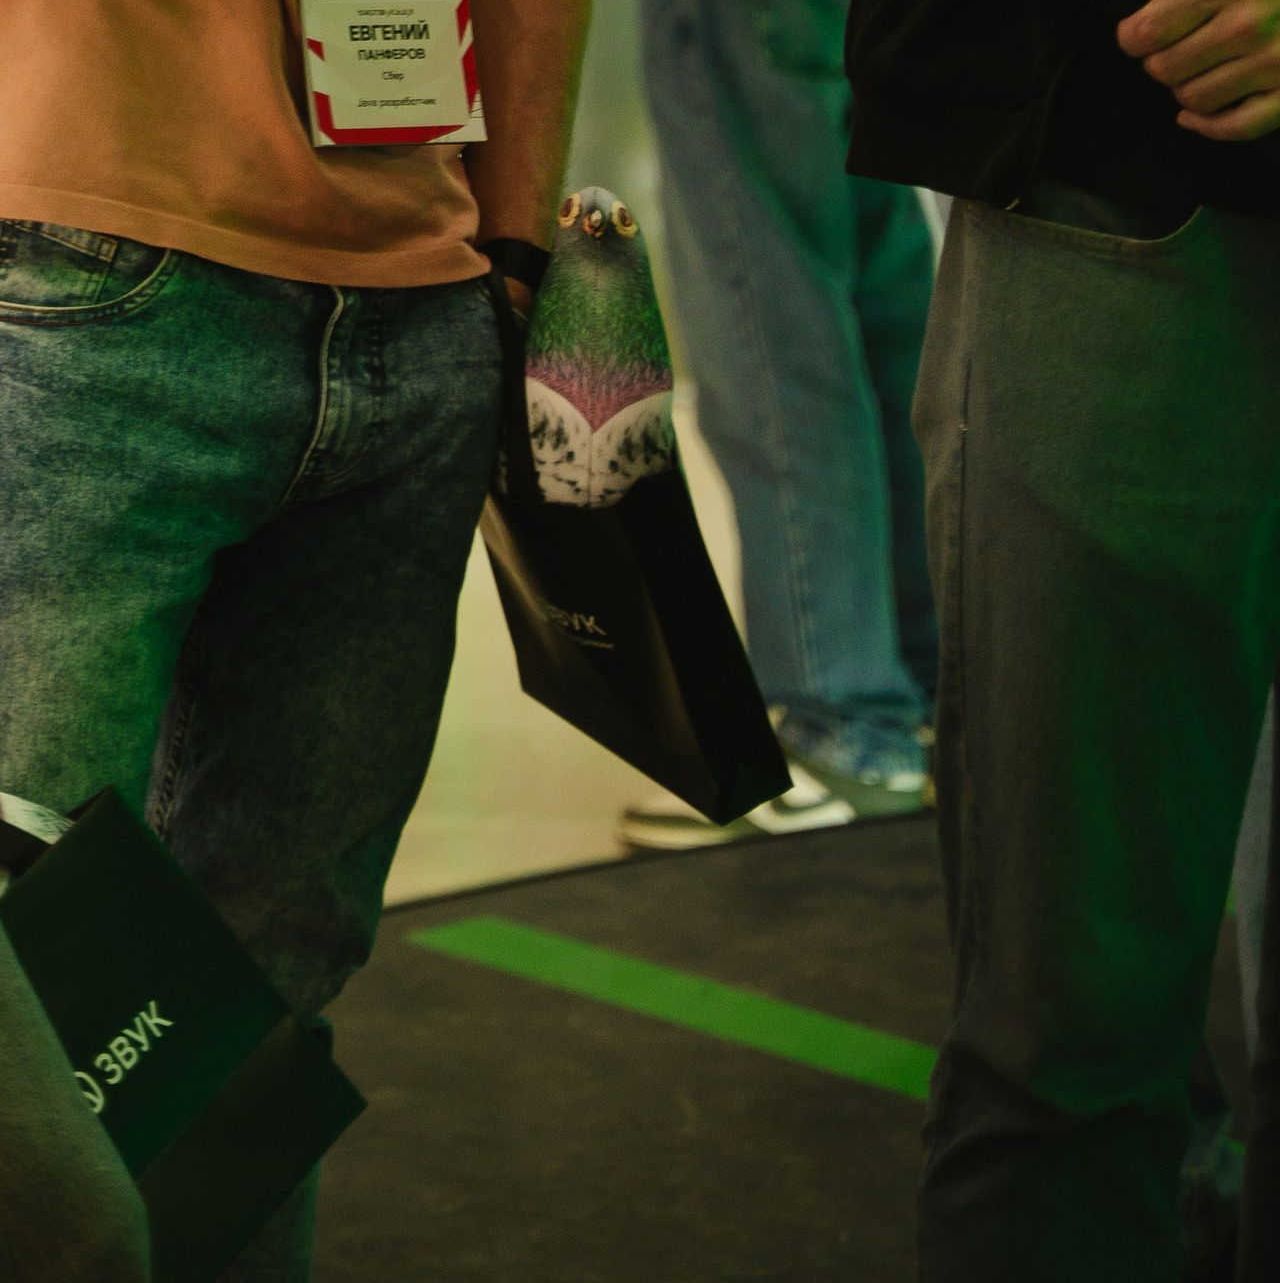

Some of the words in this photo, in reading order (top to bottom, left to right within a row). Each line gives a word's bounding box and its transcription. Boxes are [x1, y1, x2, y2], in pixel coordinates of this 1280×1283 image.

[349, 20, 430, 42] ЕВГЕНИЙ
[358, 48, 426, 61] ПАНФЕРОВ
[93, 1000, 175, 1086] ЗВУК
